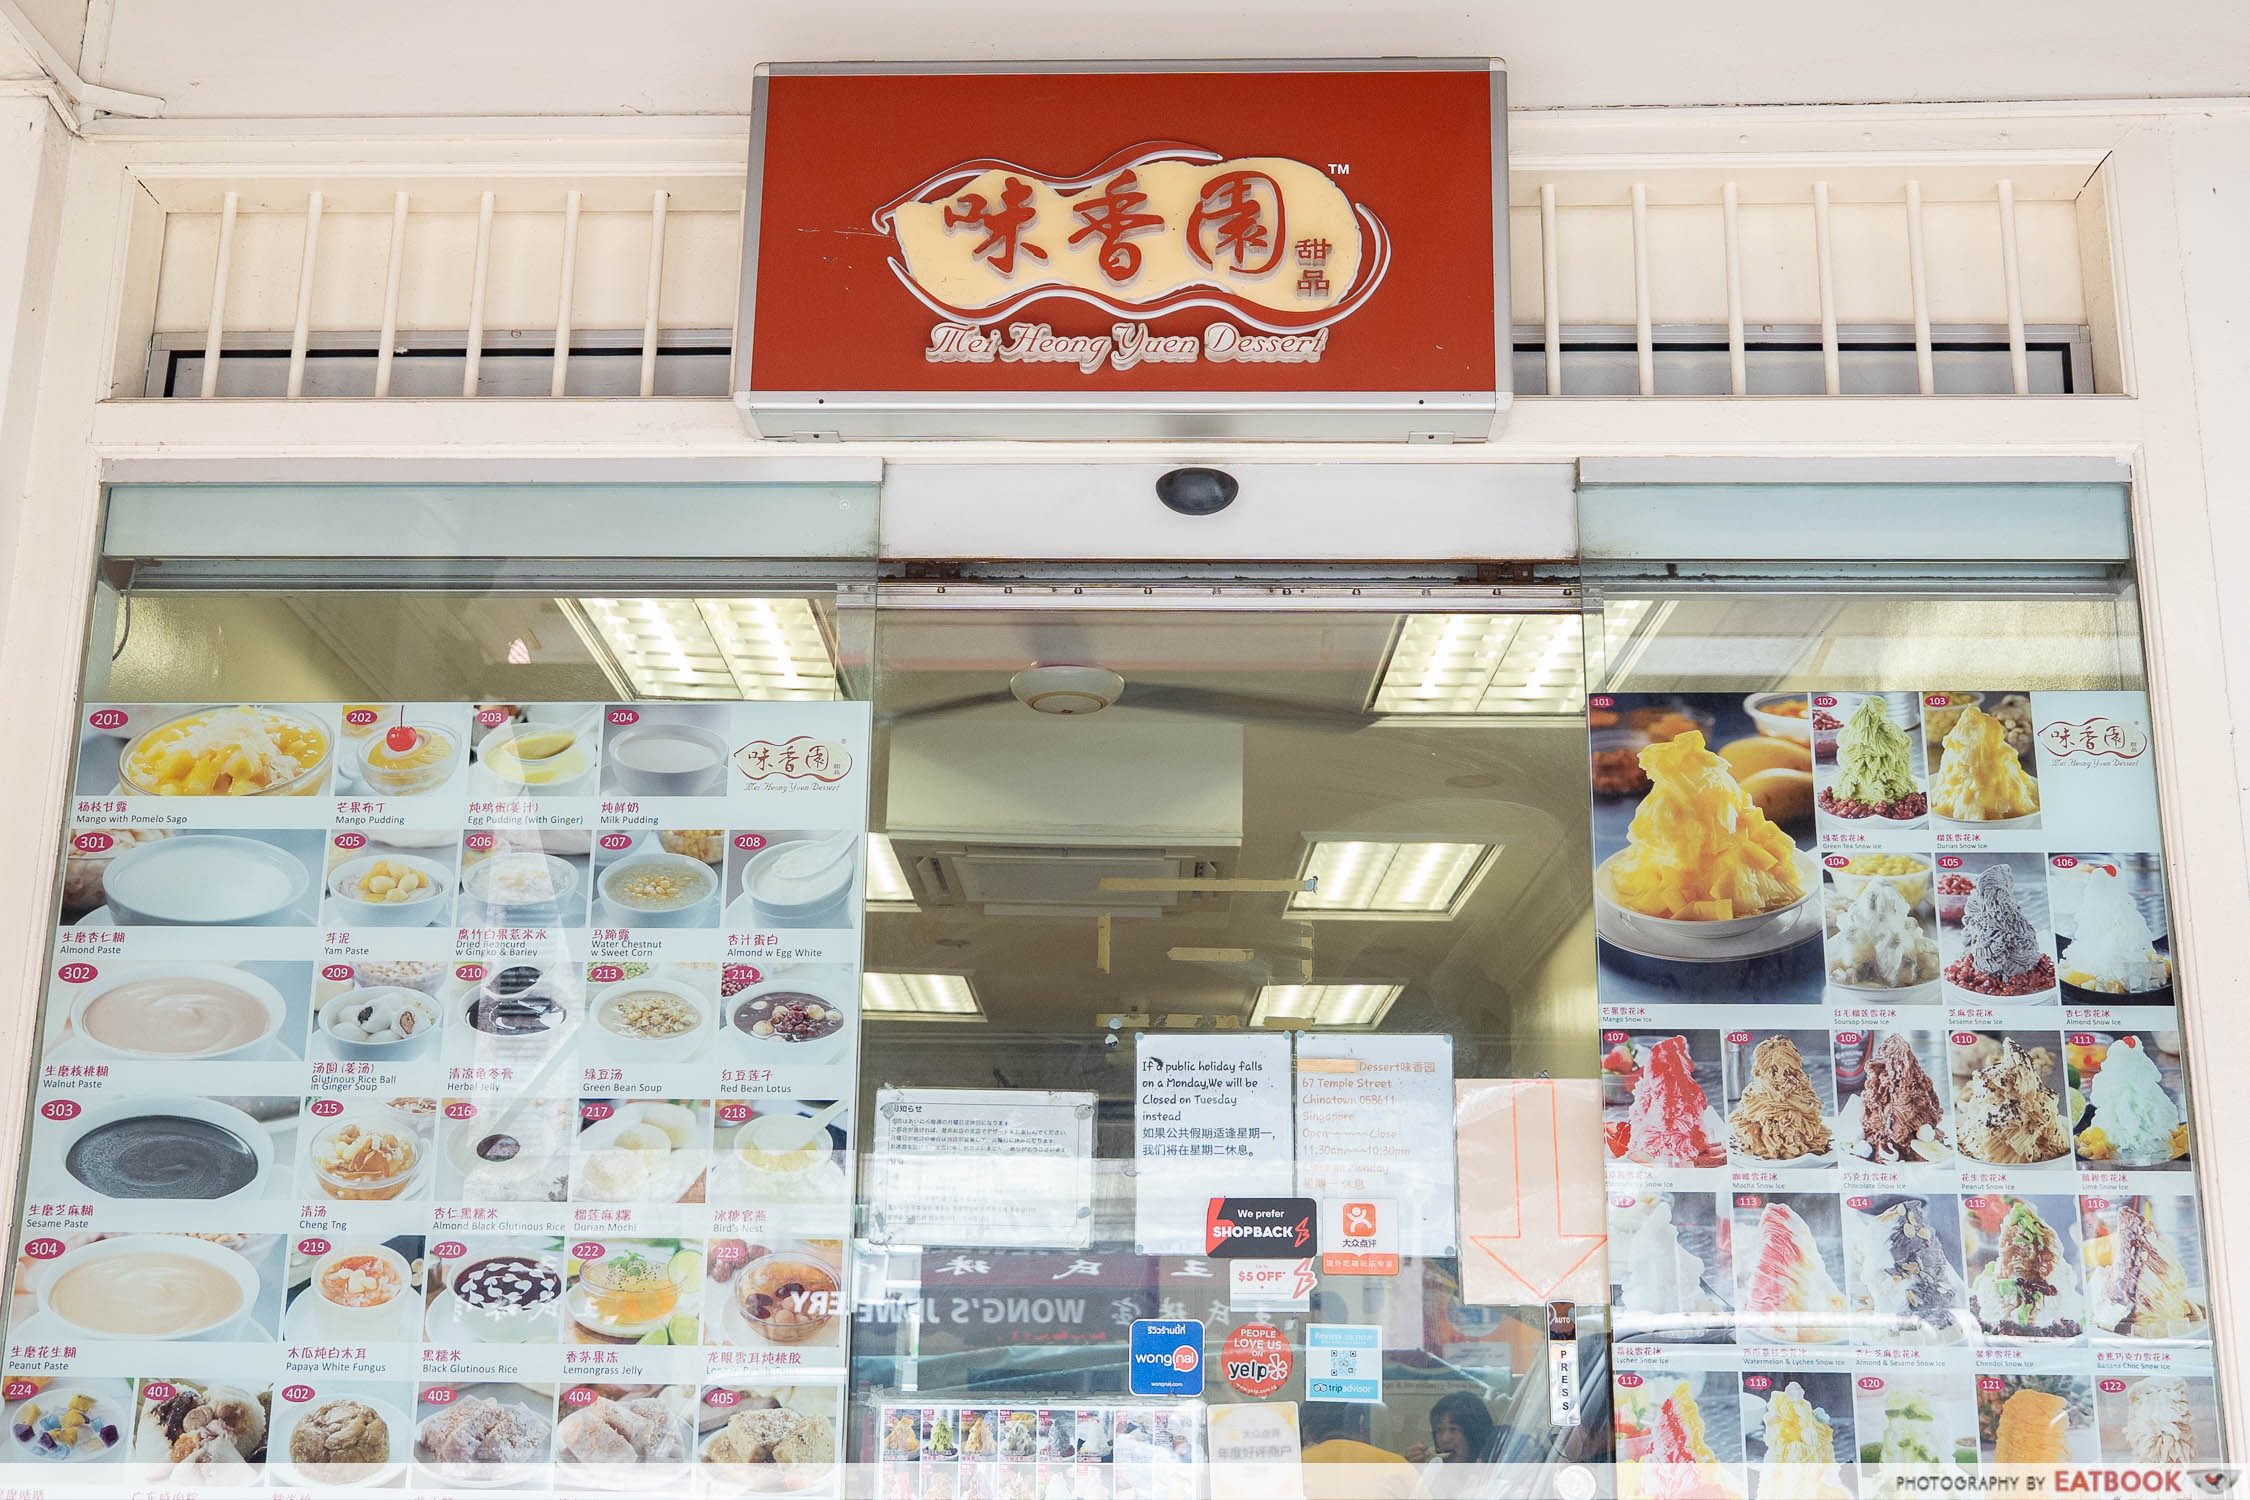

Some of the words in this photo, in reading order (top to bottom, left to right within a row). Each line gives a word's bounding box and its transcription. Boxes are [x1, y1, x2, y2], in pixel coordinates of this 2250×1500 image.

[1328, 163, 1350, 175] TM
[1294, 238, 1331, 298] 甜品
[926, 322, 1000, 363] Mei
[1000, 322, 1112, 374] Heong
[1112, 322, 1199, 371] Yuen
[1203, 322, 1328, 363] Dessert
[95, 713, 121, 726] 201
[351, 713, 372, 723] 202
[481, 712, 502, 722] 203
[612, 713, 634, 723] 204
[336, 802, 387, 813] 芒果布丁
[601, 802, 639, 813] 炖鲜奶
[76, 815, 105, 825] Mango
[108, 815, 129, 823] with
[131, 815, 164, 824] Pomelo
[166, 815, 187, 825] Sago
[335, 816, 365, 825] Mango
[368, 816, 405, 825] Pudding
[601, 816, 617, 824] Milk
[620, 816, 659, 825] Pudding
[79, 836, 106, 849] 301
[339, 836, 360, 846] 205
[470, 836, 492, 847] 206
[605, 836, 626, 847] 207
[739, 836, 761, 847] 208
[1828, 857, 1845, 865] 104
[1942, 858, 1959, 866] 105
[2056, 858, 2073, 866] 106
[592, 940, 617, 948] Water
[620, 940, 662, 948] Chestnut
[60, 946, 94, 954] Almond
[98, 946, 121, 954] Paste
[324, 947, 343, 955] Yam
[346, 947, 369, 955] Paste
[601, 948, 627, 956] Sweet
[630, 948, 653, 956] Corn
[727, 948, 761, 957] Almond
[775, 949, 792, 959] Egg
[796, 948, 822, 957] White
[64, 967, 90, 979] 302
[327, 967, 348, 978] 209
[460, 967, 482, 978] 210
[595, 968, 617, 979] 213
[732, 968, 754, 979] 214
[1607, 1033, 1624, 1041] 107
[1731, 1033, 1748, 1042] 108
[1840, 1034, 1857, 1042] 109
[1955, 1035, 1972, 1043] 110
[2074, 1035, 2091, 1044] 111
[1143, 1061, 1153, 1071] If
[1166, 1061, 1196, 1075] public
[1199, 1061, 1236, 1074] holiday
[1239, 1061, 1262, 1071] falls
[43, 1080, 75, 1088] Walnut
[78, 1080, 102, 1088] Paste
[312, 1075, 355, 1083] Glutinous
[359, 1075, 378, 1083] Rice
[381, 1075, 396, 1083] Ball
[1143, 1080, 1155, 1088] on
[1158, 1080, 1163, 1088] a
[1227, 1077, 1243, 1088] will
[1246, 1077, 1258, 1088] be
[1302, 1078, 1314, 1088] 67
[1317, 1078, 1354, 1090] Temple
[1357, 1078, 1392, 1088] Street
[311, 1082, 320, 1090] in
[323, 1082, 354, 1092] Ginger
[356, 1082, 377, 1092] Soup
[583, 1083, 611, 1092] Green
[614, 1083, 637, 1092] Bean
[640, 1083, 662, 1093] Soup
[721, 1084, 737, 1092] Red
[741, 1084, 764, 1092] Bean
[768, 1084, 791, 1093] Lotus
[1143, 1094, 1176, 1105] Closed
[1180, 1096, 1191, 1105] on
[1194, 1094, 1237, 1107] Tuesday
[1302, 1095, 1356, 1105] Chinatown
[47, 1104, 73, 1116] 303
[316, 1104, 338, 1114] 215
[449, 1105, 471, 1117] 216
[586, 1106, 608, 1117] 217
[724, 1107, 746, 1118] 218
[1143, 1111, 1181, 1122] instead
[1740, 1198, 1757, 1206] 113
[1851, 1199, 1868, 1207] 114
[1968, 1199, 1985, 1208] 115
[2087, 1200, 2104, 1208] 116
[1238, 1210, 1253, 1218] We
[1256, 1209, 1284, 1220] prefer
[27, 1220, 62, 1228] Sesame
[65, 1220, 88, 1228] Paste
[300, 1220, 327, 1230] Cheng
[330, 1221, 347, 1230] Tng
[1213, 1226, 1293, 1238] SHOPBACK
[30, 1242, 57, 1255] 304
[303, 1241, 325, 1252] 219
[1342, 1238, 1376, 1248] 大众点评
[439, 1245, 461, 1256] 220
[577, 1245, 599, 1256] 222
[718, 1247, 739, 1258] 223
[1238, 1271, 1252, 1283] $5
[1241, 1329, 1276, 1338] PEOPLE
[1234, 1338, 1264, 1350] LOVE
[1267, 1340, 1281, 1350] US
[9, 1361, 41, 1370] Peanut
[44, 1361, 69, 1370] Paste
[286, 1362, 319, 1373] Papaya
[322, 1362, 349, 1371] White
[353, 1362, 386, 1373] Fungus
[423, 1365, 446, 1374] Black
[450, 1365, 494, 1374] Glutinous
[498, 1365, 518, 1374] Rice
[563, 1365, 618, 1376] Lemongrass
[622, 1365, 643, 1377] Jelly
[1229, 1361, 1268, 1382] yelp
[1560, 1350, 1569, 1411] PRESS
[1621, 1376, 1638, 1385] 117
[1750, 1378, 1767, 1387] 118
[1862, 1379, 1880, 1388] 120
[1983, 1380, 2000, 1389] 121
[10, 1384, 32, 1395] 224
[147, 1385, 169, 1397] 401
[2104, 1382, 2122, 1391] 122
[287, 1387, 309, 1399] 402
[429, 1389, 450, 1401] 403
[569, 1390, 592, 1403] 404
[711, 1392, 734, 1404] 405
